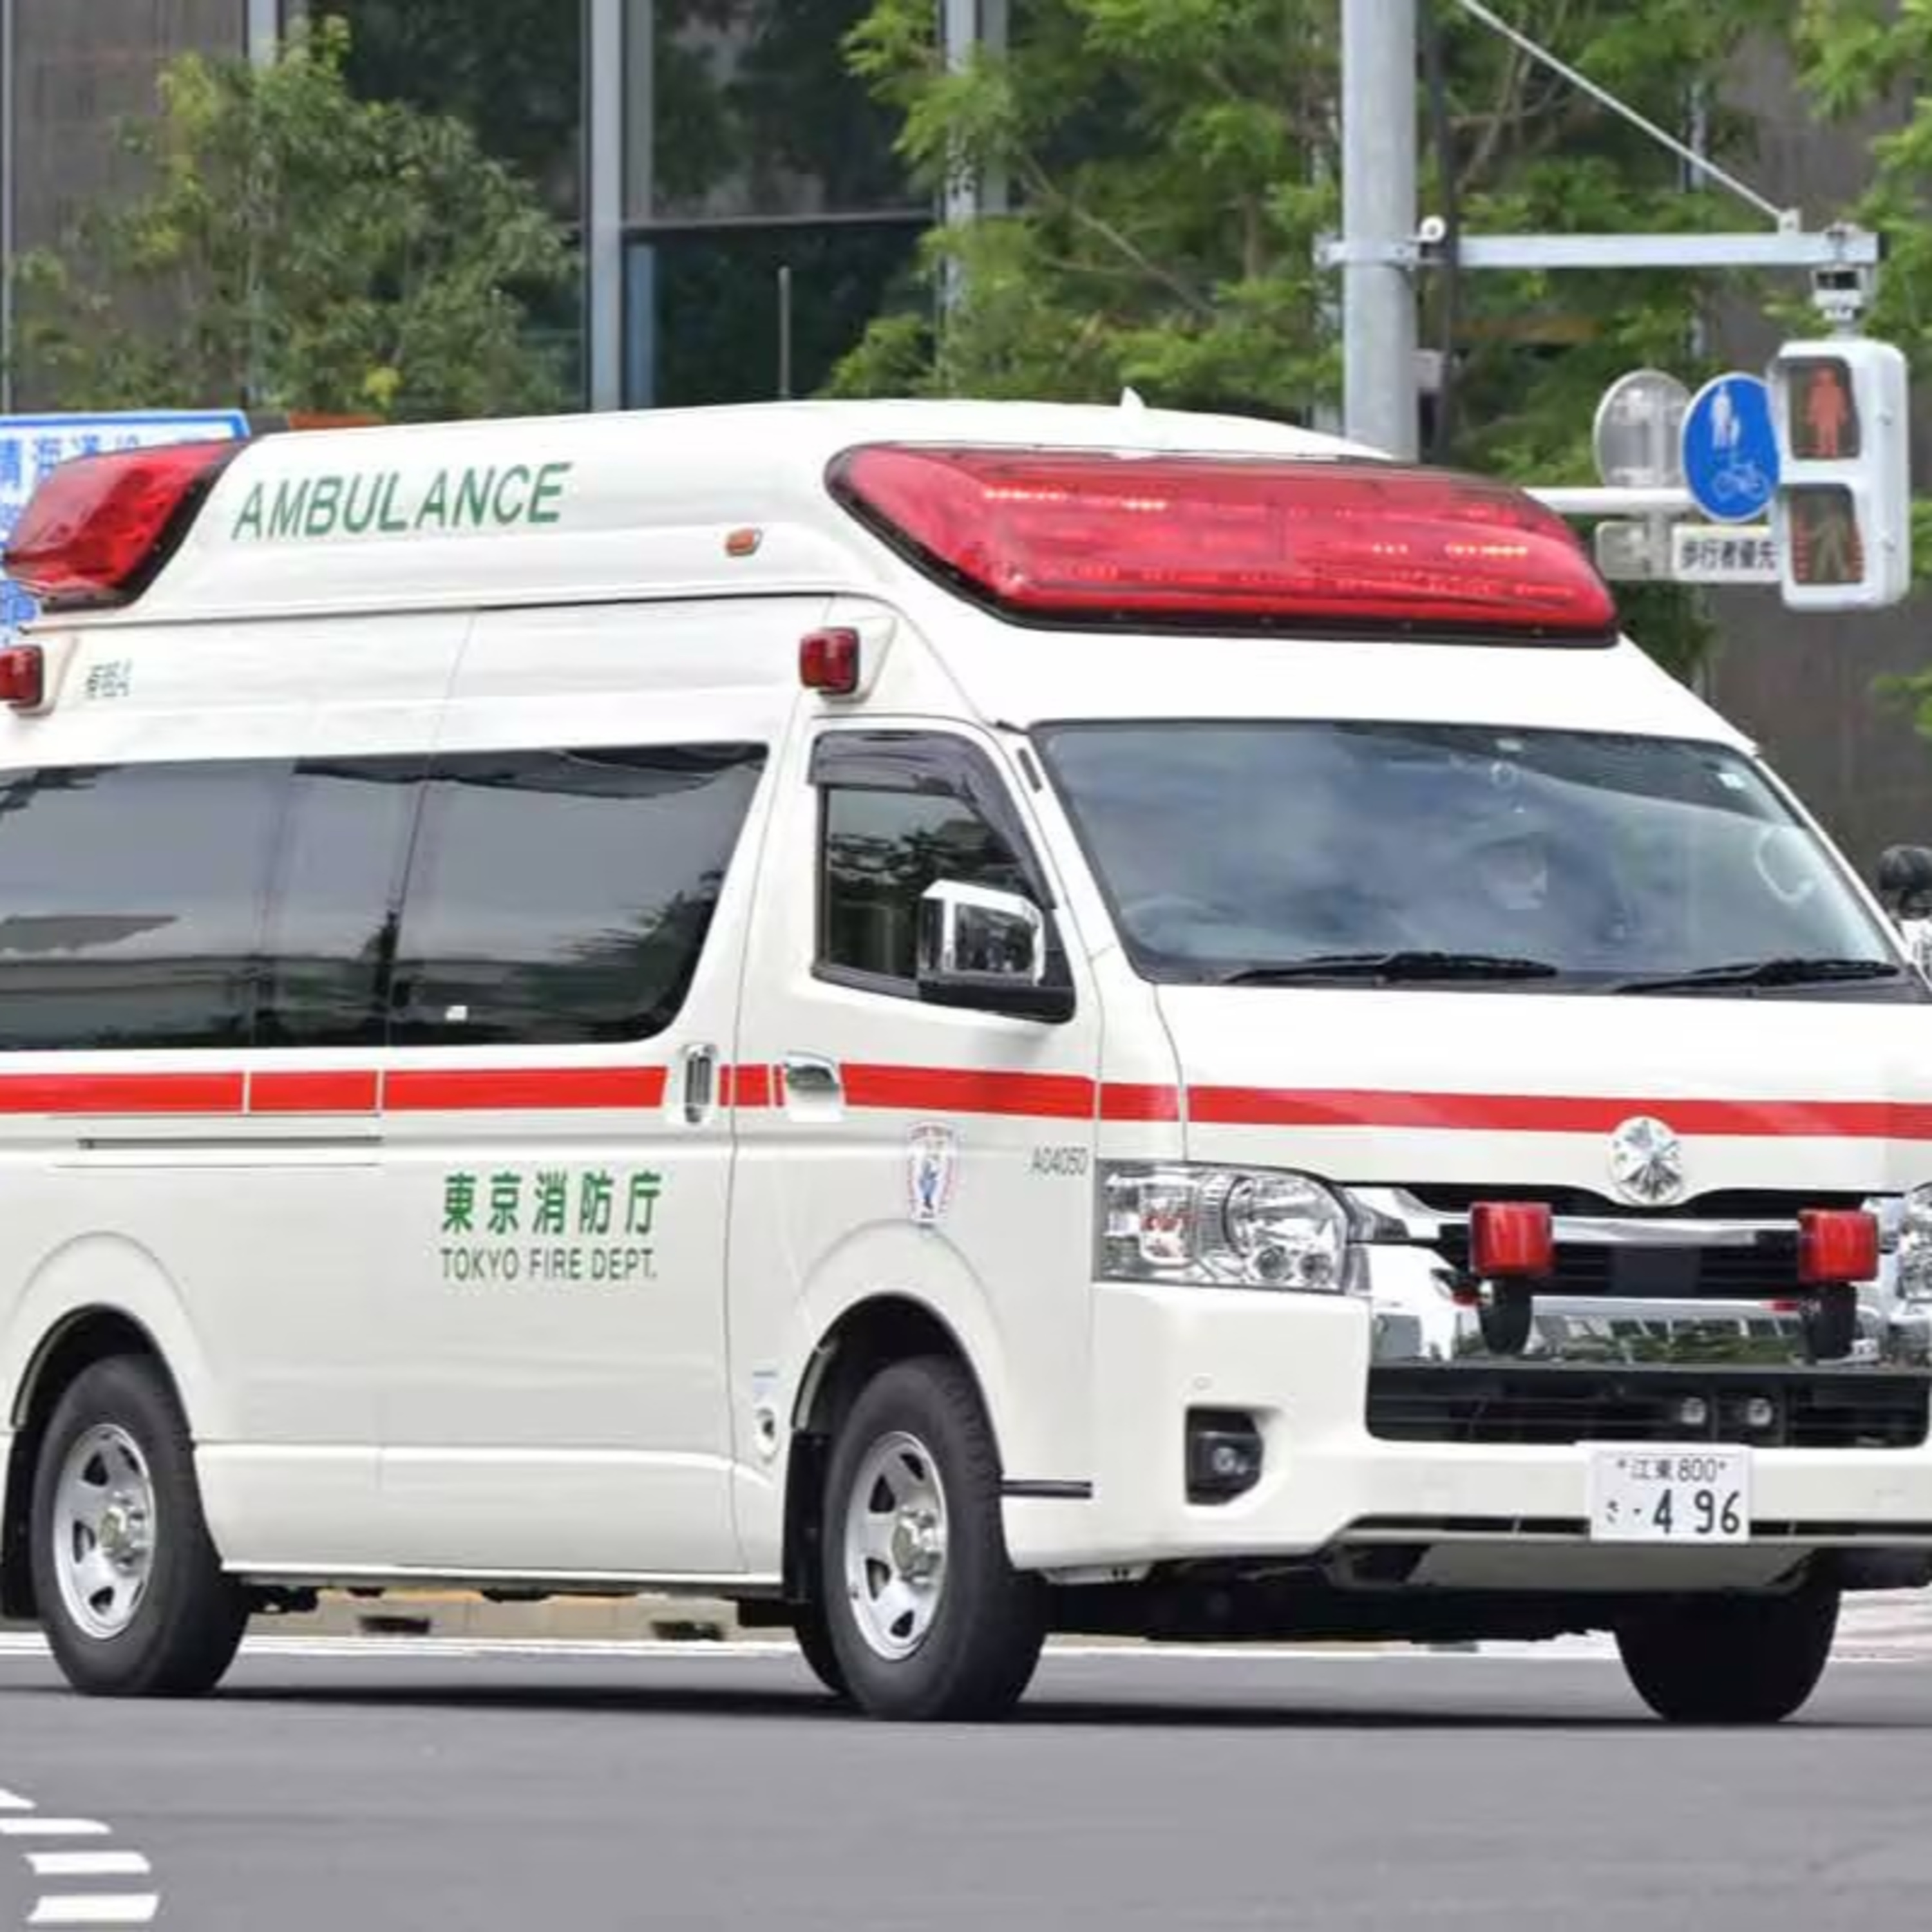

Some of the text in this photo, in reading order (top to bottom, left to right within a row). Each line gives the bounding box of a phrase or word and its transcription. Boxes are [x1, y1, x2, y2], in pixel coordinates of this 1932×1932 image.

[231, 462, 573, 540] AMBULANCE
[442, 1171, 661, 1235] 東京消防庁
[440, 1247, 658, 1280] TOKYO FIRE DEPT.
